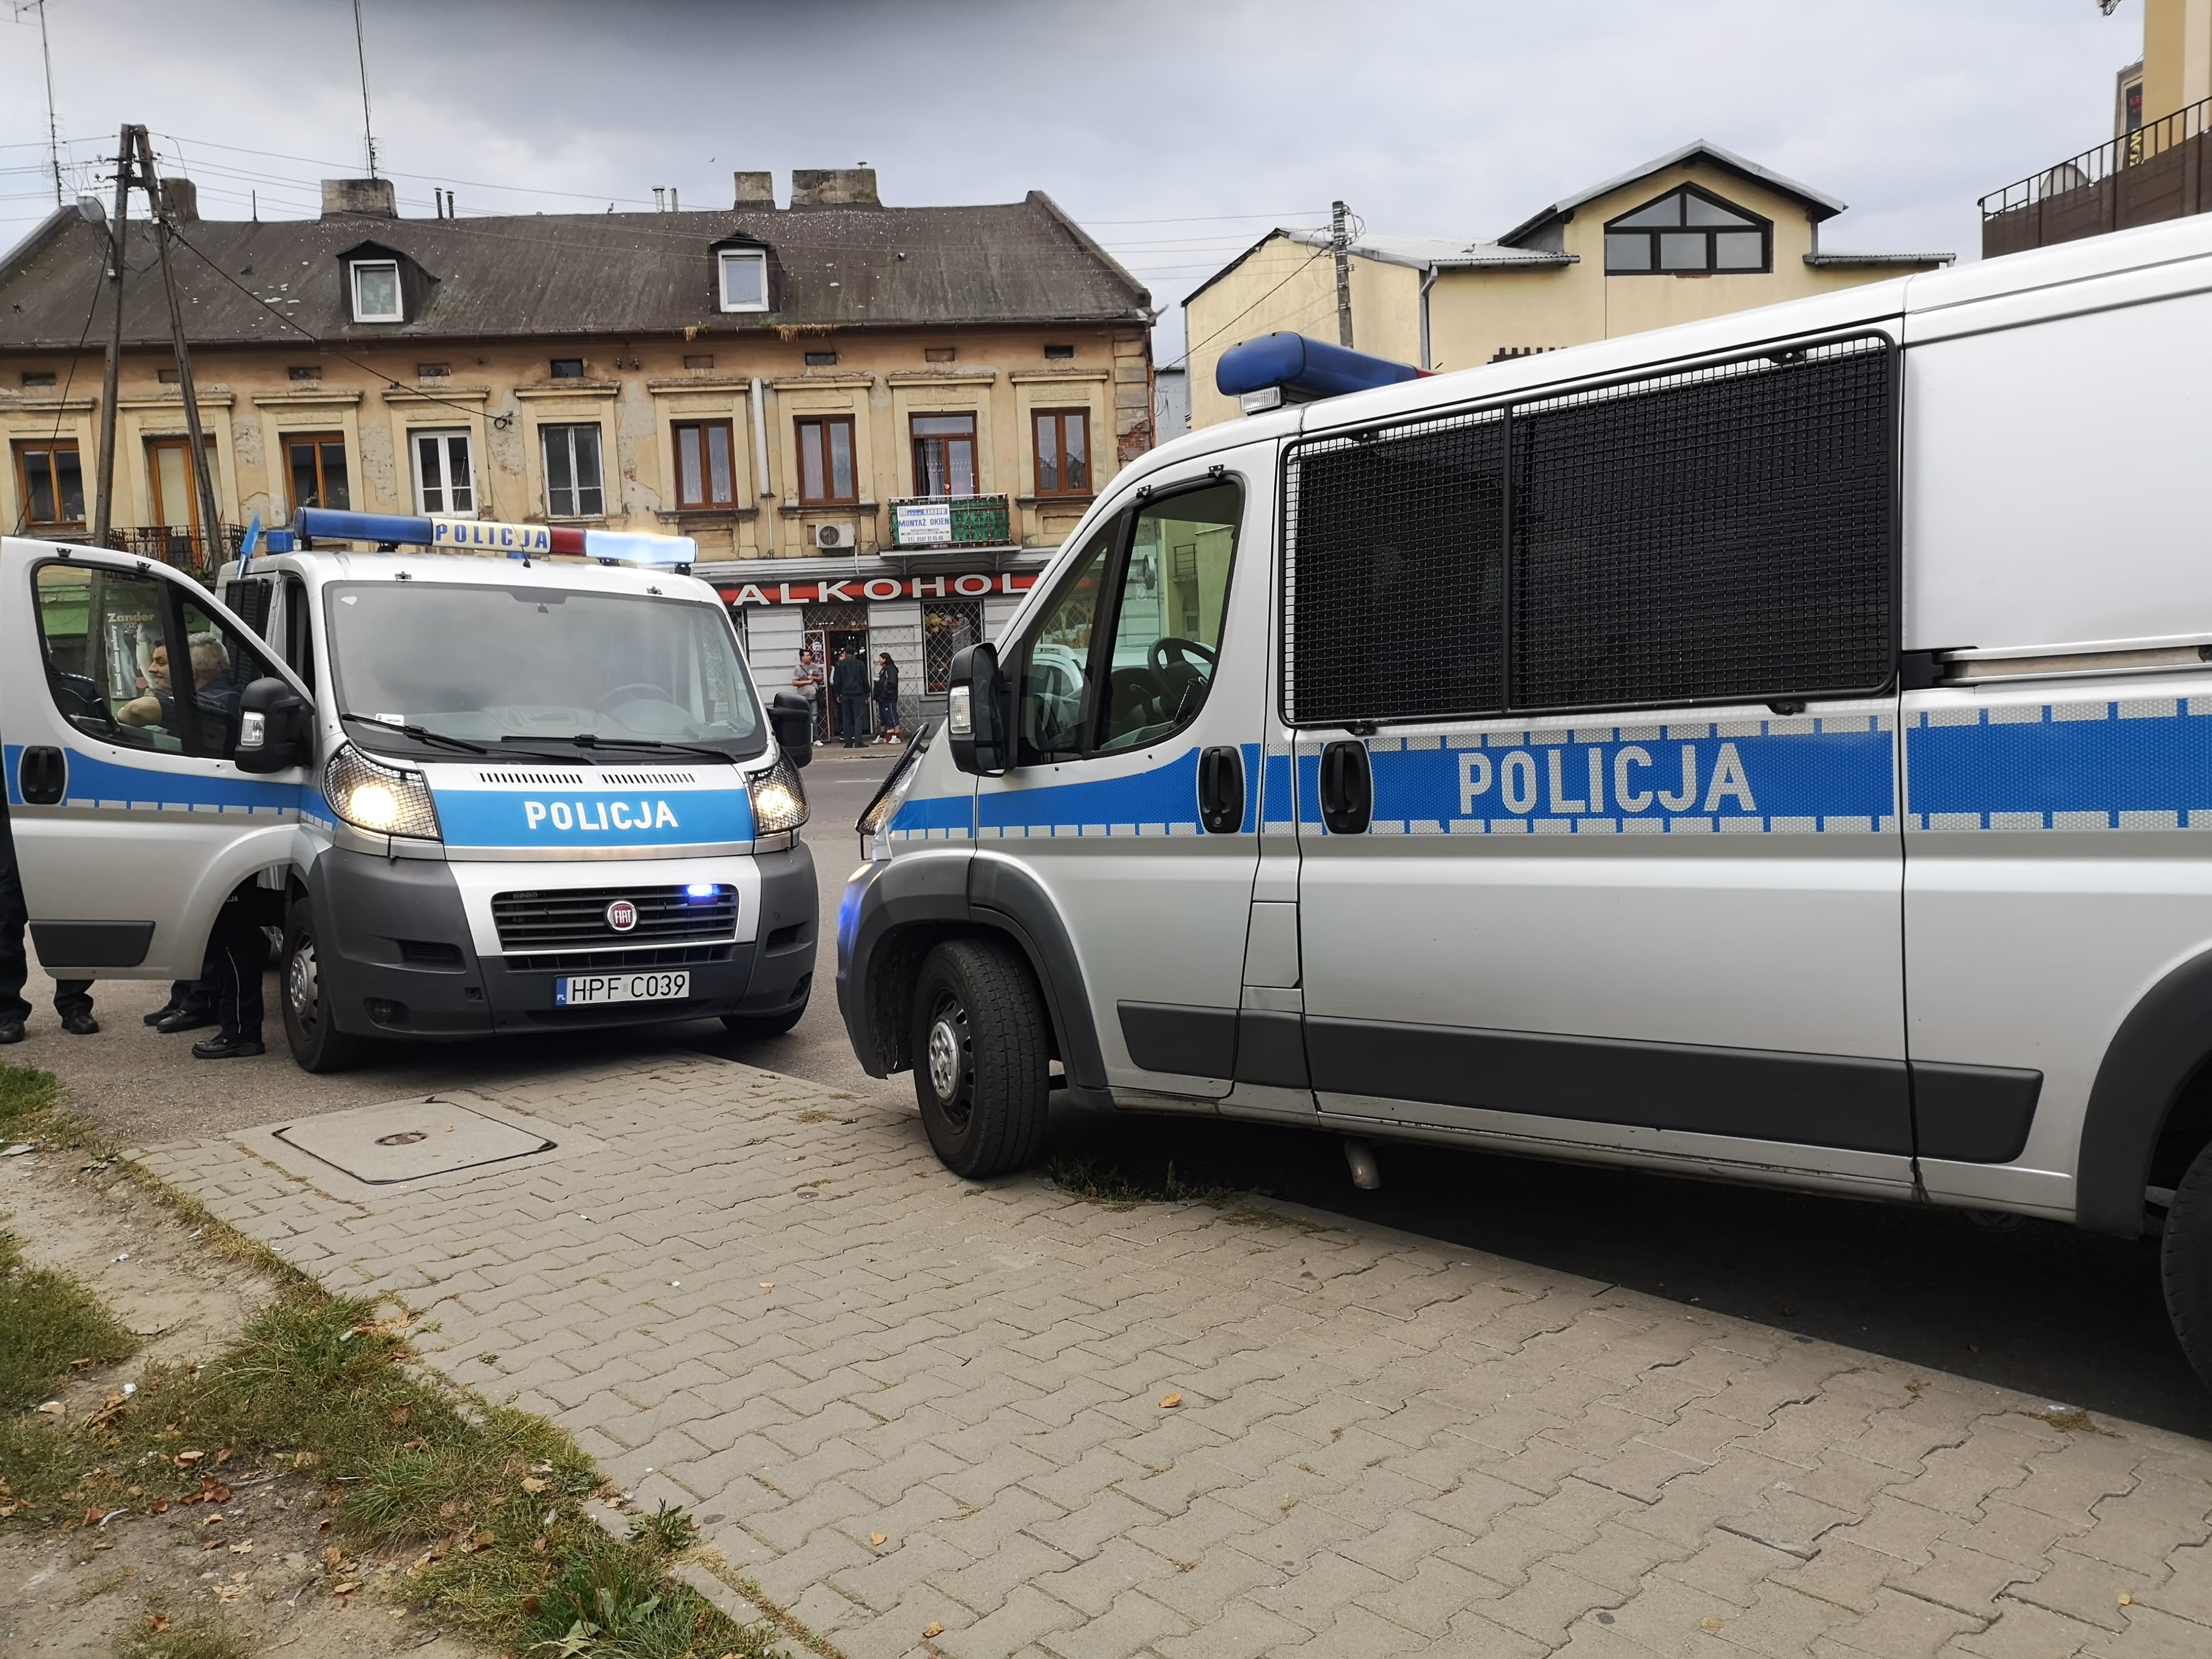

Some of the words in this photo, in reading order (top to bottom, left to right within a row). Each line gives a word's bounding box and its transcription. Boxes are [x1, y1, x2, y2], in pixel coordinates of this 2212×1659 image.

[435, 523, 548, 549] POLICJA
[899, 518, 926, 527] MONTAŻ
[733, 572, 1043, 607] ALKOHOL
[107, 611, 155, 623] Zander
[1458, 743, 1757, 814] POLICJA
[524, 801, 678, 830] POLICJA
[614, 909, 632, 924] FIAT
[572, 977, 622, 1002] HPF
[631, 974, 686, 998] C039
